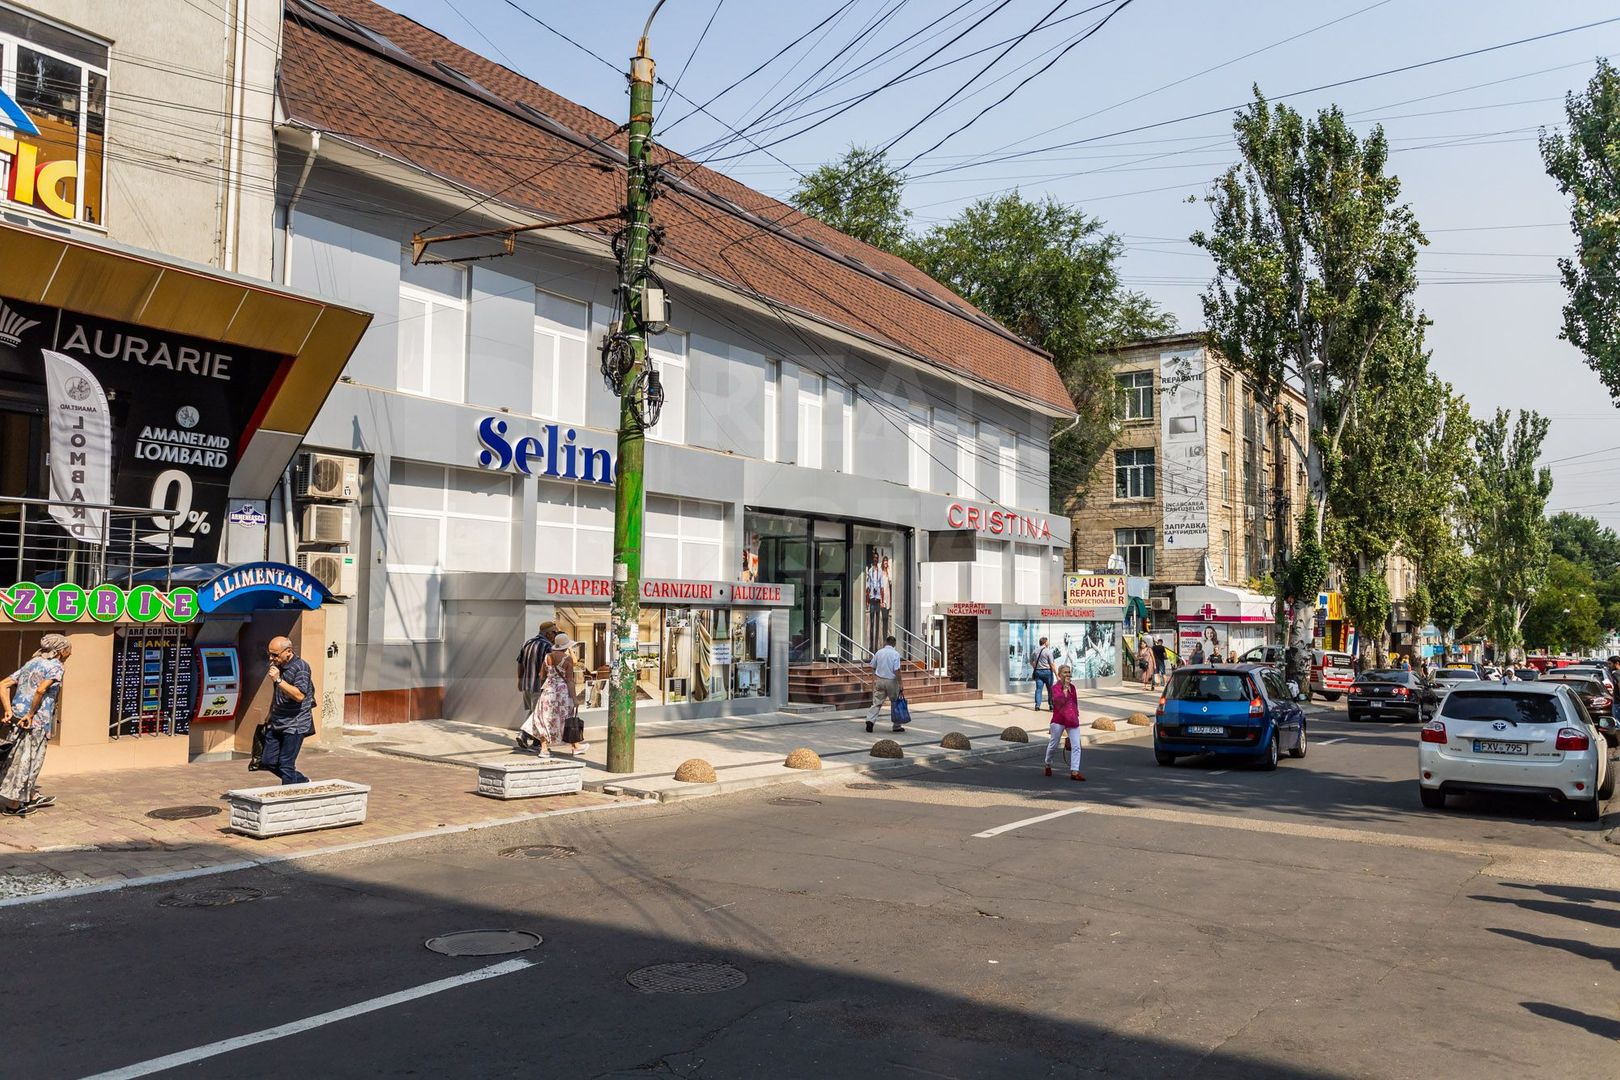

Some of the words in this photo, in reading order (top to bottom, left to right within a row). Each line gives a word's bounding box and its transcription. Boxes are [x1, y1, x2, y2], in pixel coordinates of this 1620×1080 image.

[63, 325, 233, 380] AURARIE
[140, 426, 230, 449] AMANET.MD
[479, 416, 617, 484] Selin
[134, 442, 228, 468] LOMBARD
[948, 503, 1051, 540] CRISTINA
[1165, 522, 1207, 530] ЗАПРАВКА
[1167, 535, 1174, 544] 4
[547, 577, 613, 597] DRAPER
[643, 581, 713, 599] CARNIZURI
[730, 583, 781, 602] JALUZELE
[1081, 577, 1104, 588] AUR
[1117, 577, 1125, 605] AUR
[1481, 740, 1499, 751] FXV
[1505, 743, 1523, 753] 795
